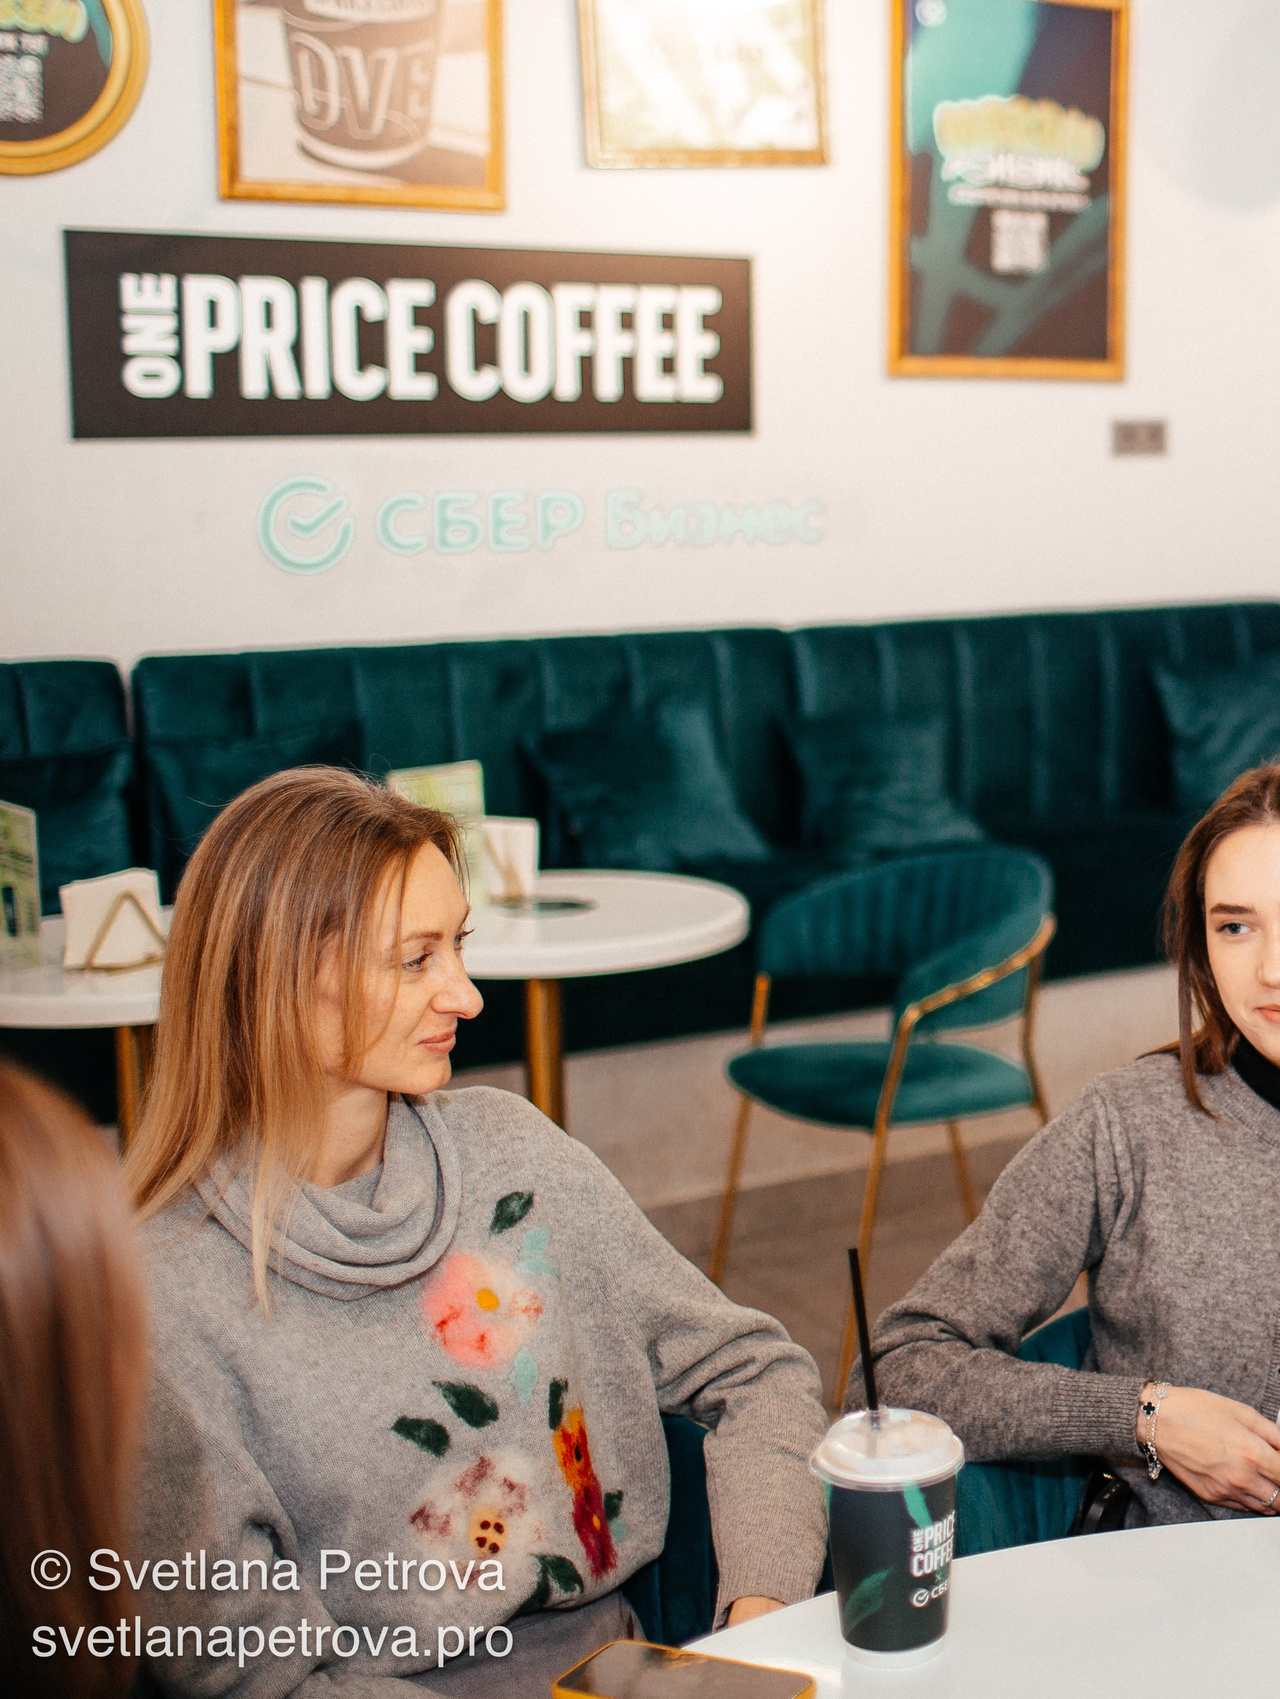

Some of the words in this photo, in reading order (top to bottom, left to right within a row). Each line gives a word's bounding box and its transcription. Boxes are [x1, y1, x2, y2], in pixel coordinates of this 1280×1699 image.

[120, 272, 183, 400] ONE
[182, 274, 439, 400] PRICE
[445, 278, 725, 403] COFFEE
[377, 491, 585, 554] СБЕР
[603, 491, 825, 550] Бизнес
[913, 1528, 924, 1553] ONE
[924, 1510, 955, 1551] PRIC
